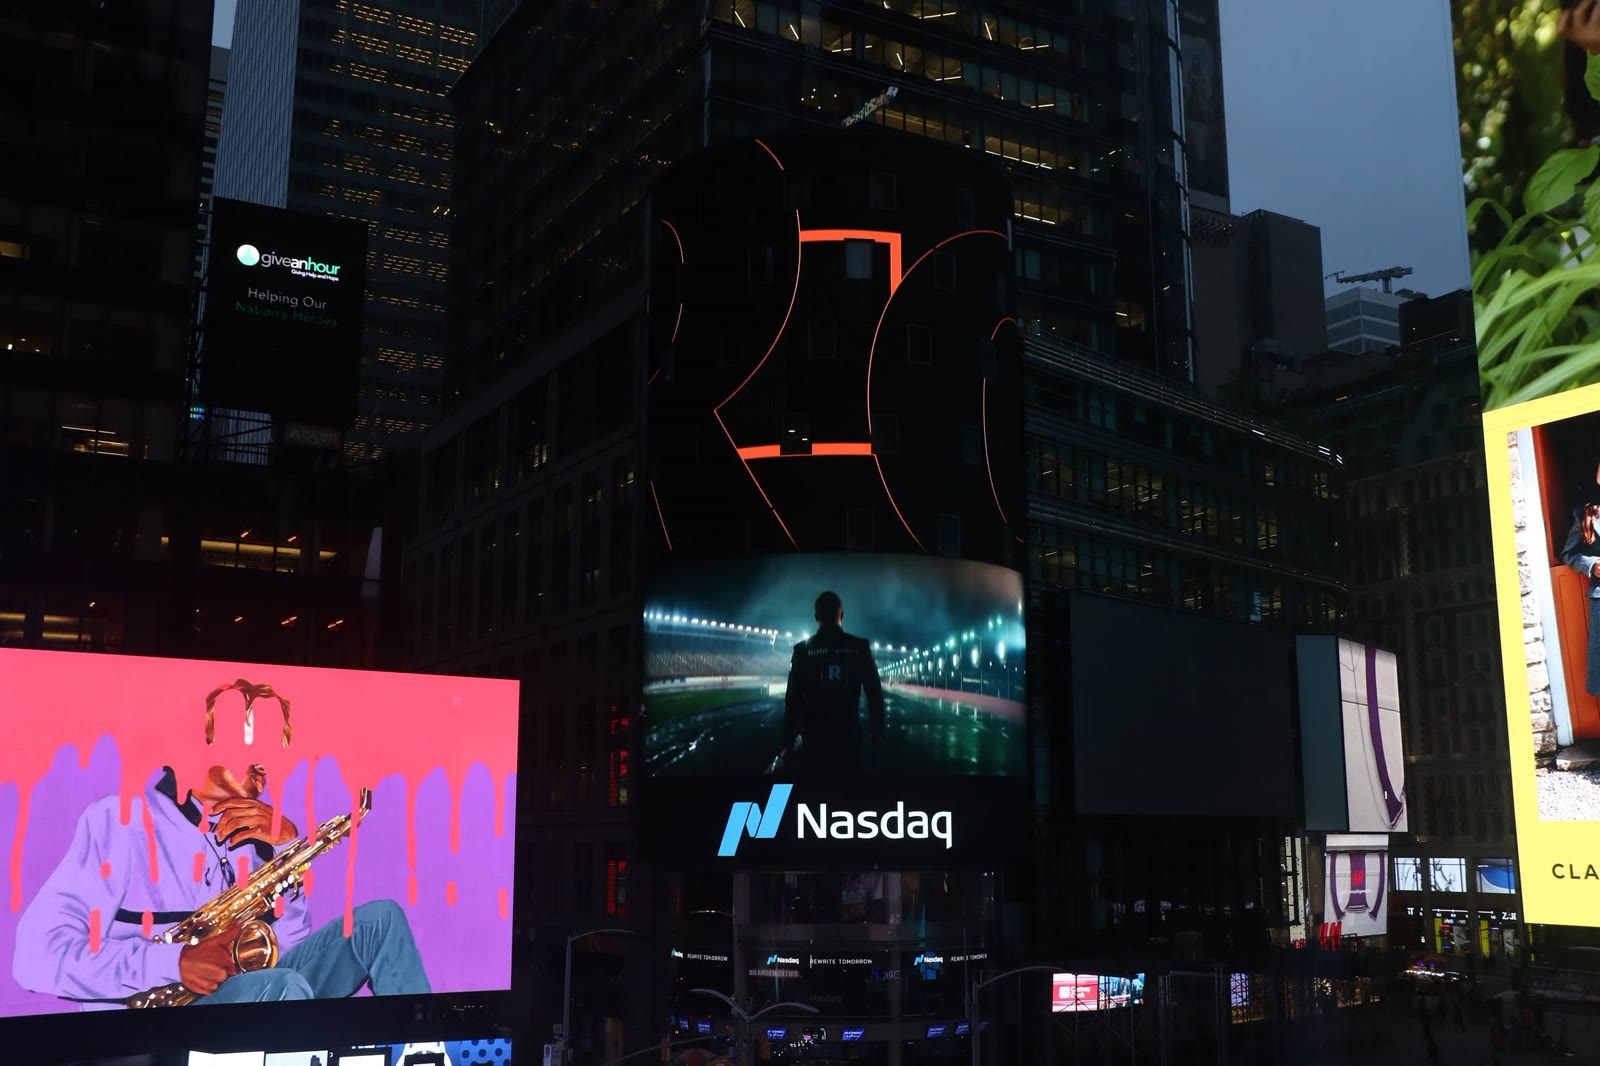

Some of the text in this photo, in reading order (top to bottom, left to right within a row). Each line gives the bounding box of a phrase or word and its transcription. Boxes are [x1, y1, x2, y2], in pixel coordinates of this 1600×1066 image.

[261, 251, 341, 275] giveanhour
[291, 269, 305, 277] Giving
[306, 271, 316, 279] Help
[248, 287, 328, 309] Helping Our
[828, 664, 841, 680] R
[797, 801, 953, 850] Nasdaq
[1552, 863, 1600, 880] CLA
[777, 955, 799, 965] Nasdaq
[924, 956, 943, 964] Nasdaq
